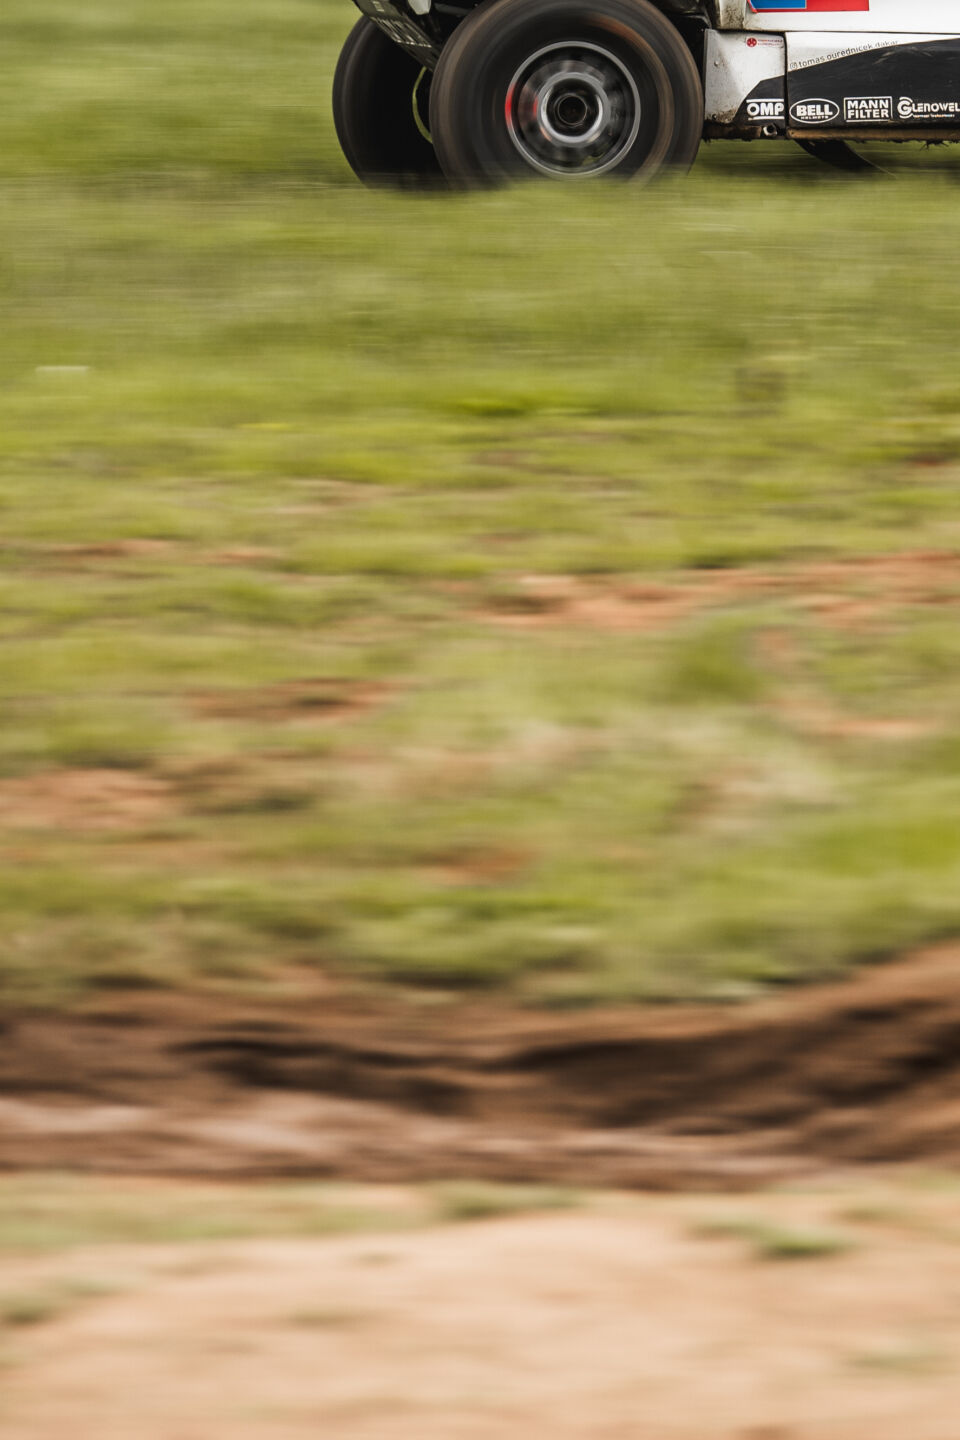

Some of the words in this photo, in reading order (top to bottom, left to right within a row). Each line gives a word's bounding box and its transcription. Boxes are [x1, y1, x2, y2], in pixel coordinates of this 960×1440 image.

[747, 102, 784, 116] OMP
[796, 104, 833, 116] BELL
[847, 100, 889, 109] MANN
[847, 109, 890, 119] FILTER
